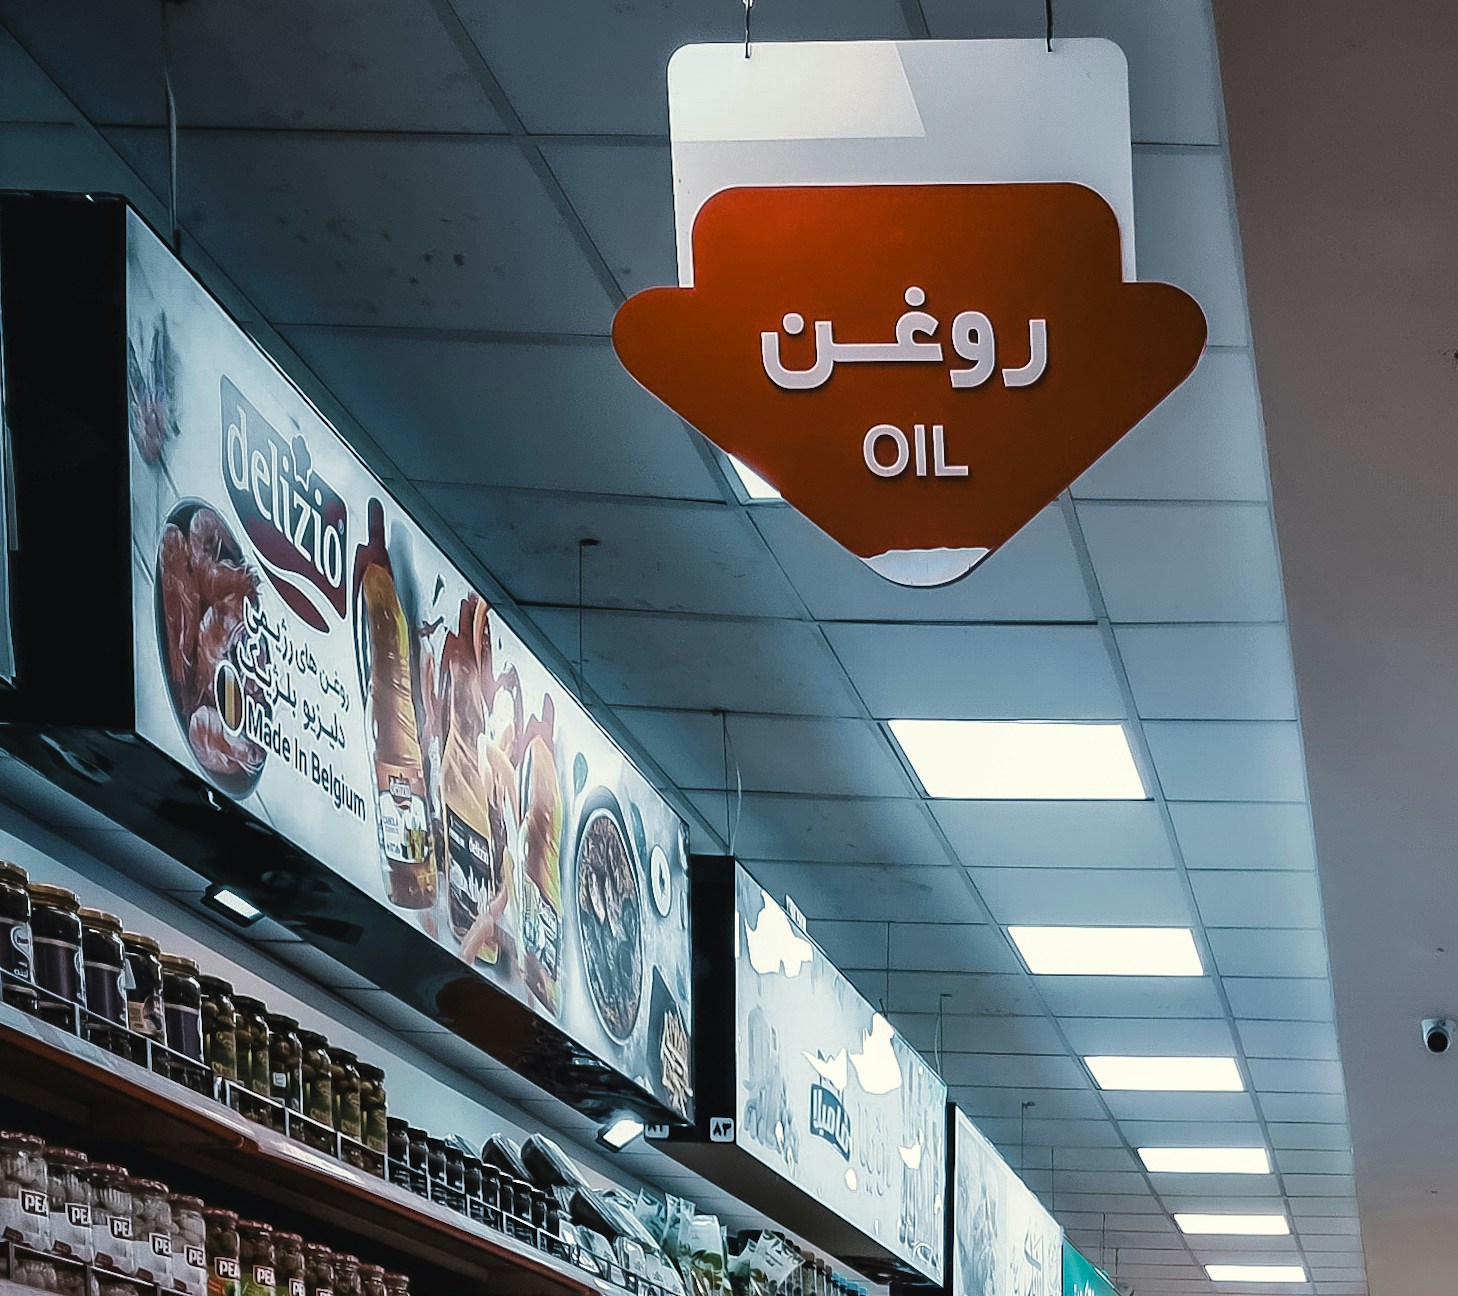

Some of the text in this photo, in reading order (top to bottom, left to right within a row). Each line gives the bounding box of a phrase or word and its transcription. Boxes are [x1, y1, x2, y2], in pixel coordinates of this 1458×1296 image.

[761, 286, 1047, 389] روغن
[228, 405, 342, 588] delizio
[863, 424, 968, 477] OIL
[249, 701, 366, 821] Made In Belgium
[219, 1260, 241, 1278] PEA
